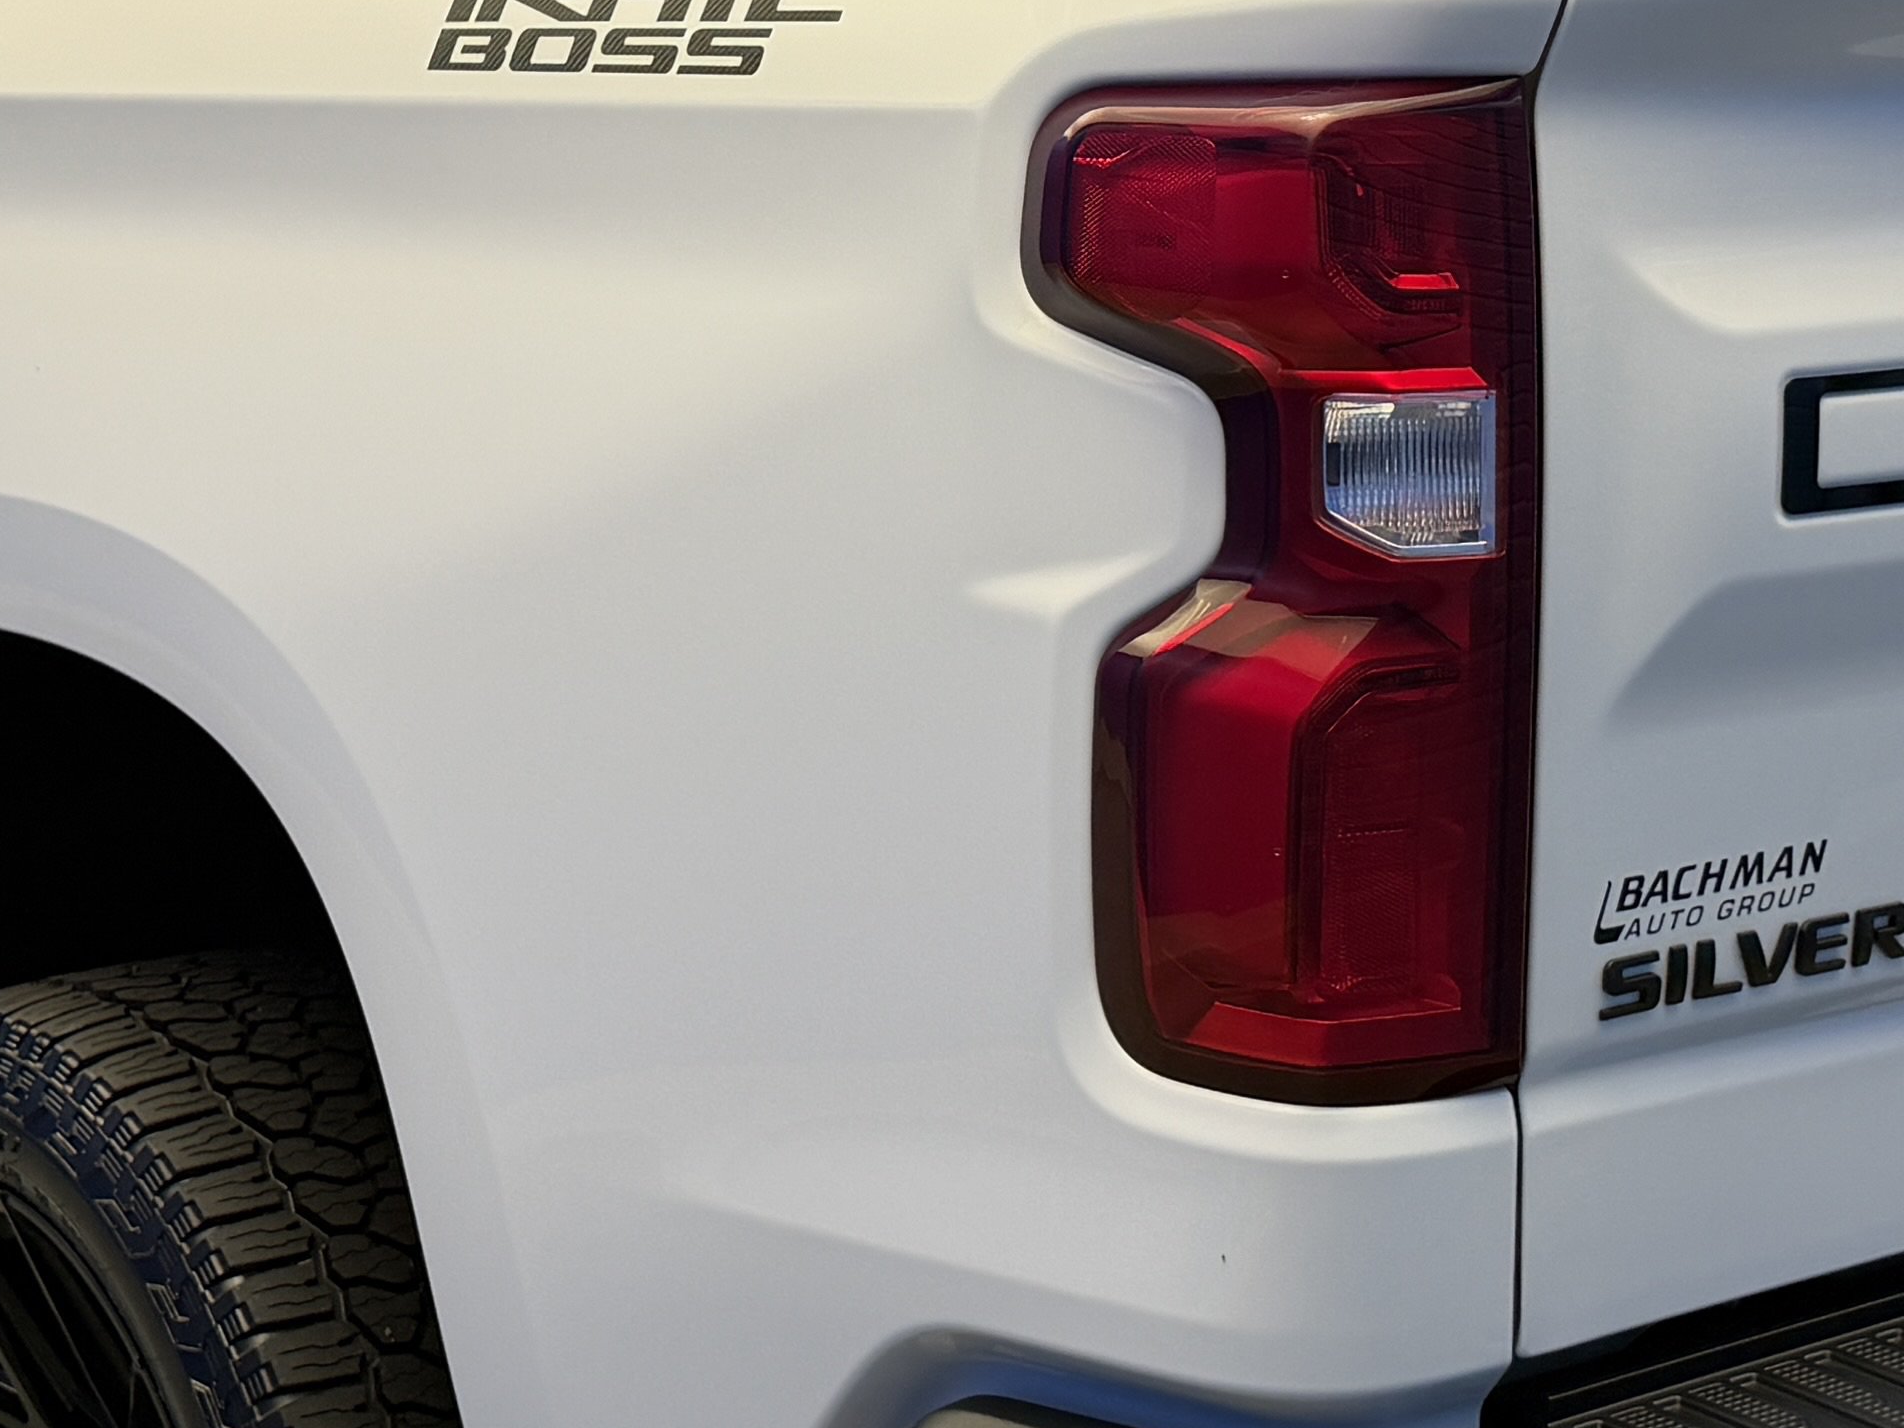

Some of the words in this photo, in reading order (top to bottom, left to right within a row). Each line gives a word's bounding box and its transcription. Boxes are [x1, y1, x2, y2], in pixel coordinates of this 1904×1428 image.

[427, 27, 773, 75] BOSS
[1615, 838, 1828, 912] BACHMAN
[1623, 904, 1703, 941] AUTO
[1716, 882, 1816, 921] GROUP
